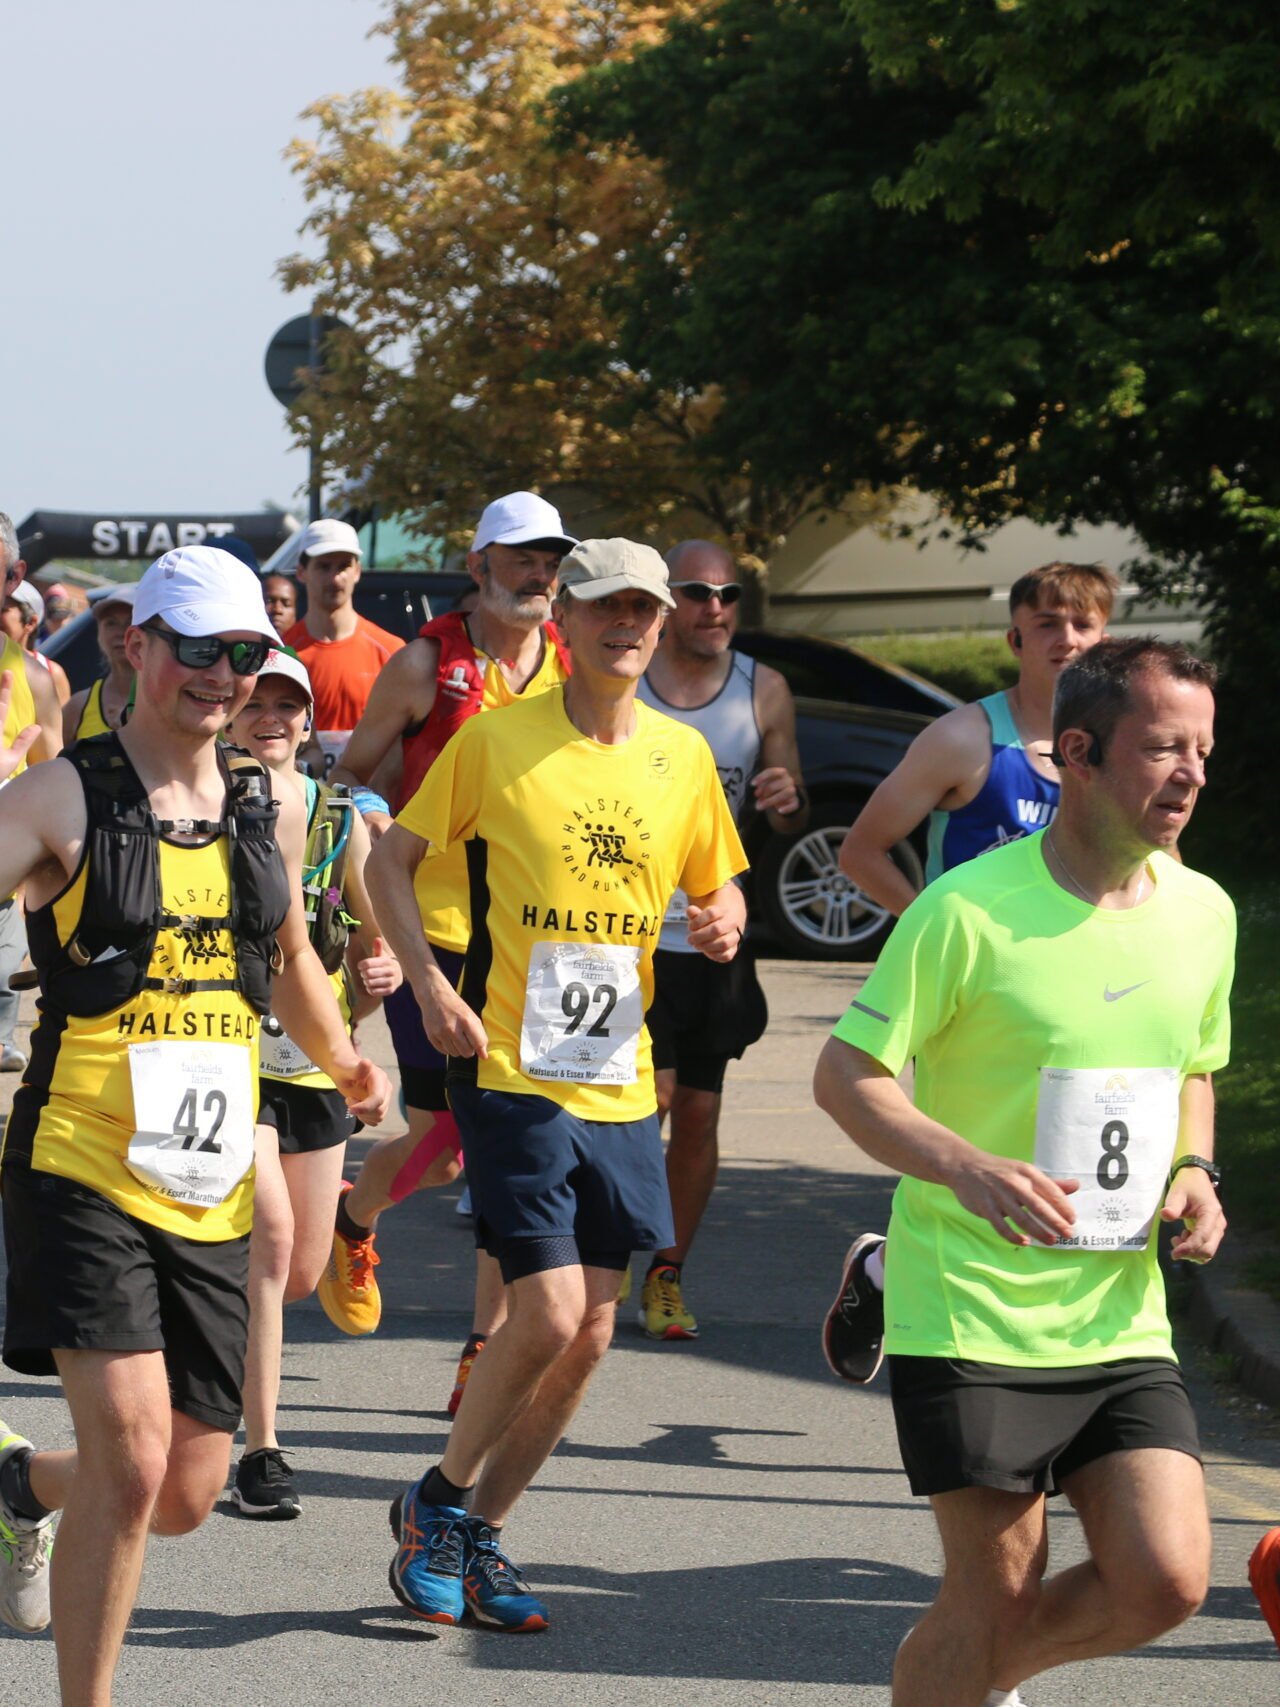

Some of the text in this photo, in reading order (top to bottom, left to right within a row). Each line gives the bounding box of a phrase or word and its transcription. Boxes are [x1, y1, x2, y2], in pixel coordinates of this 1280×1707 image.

[522, 904, 659, 937] HALSTEAD
[561, 981, 618, 1038] 92
[118, 1011, 256, 1040] HALSTEAD
[566, 1070, 584, 1079] Essex
[173, 1088, 228, 1155] 42
[1096, 1119, 1130, 1191] 8
[166, 1188, 186, 1198] Essex
[1082, 1236, 1088, 1245] &
[1091, 1236, 1115, 1245] Essex
